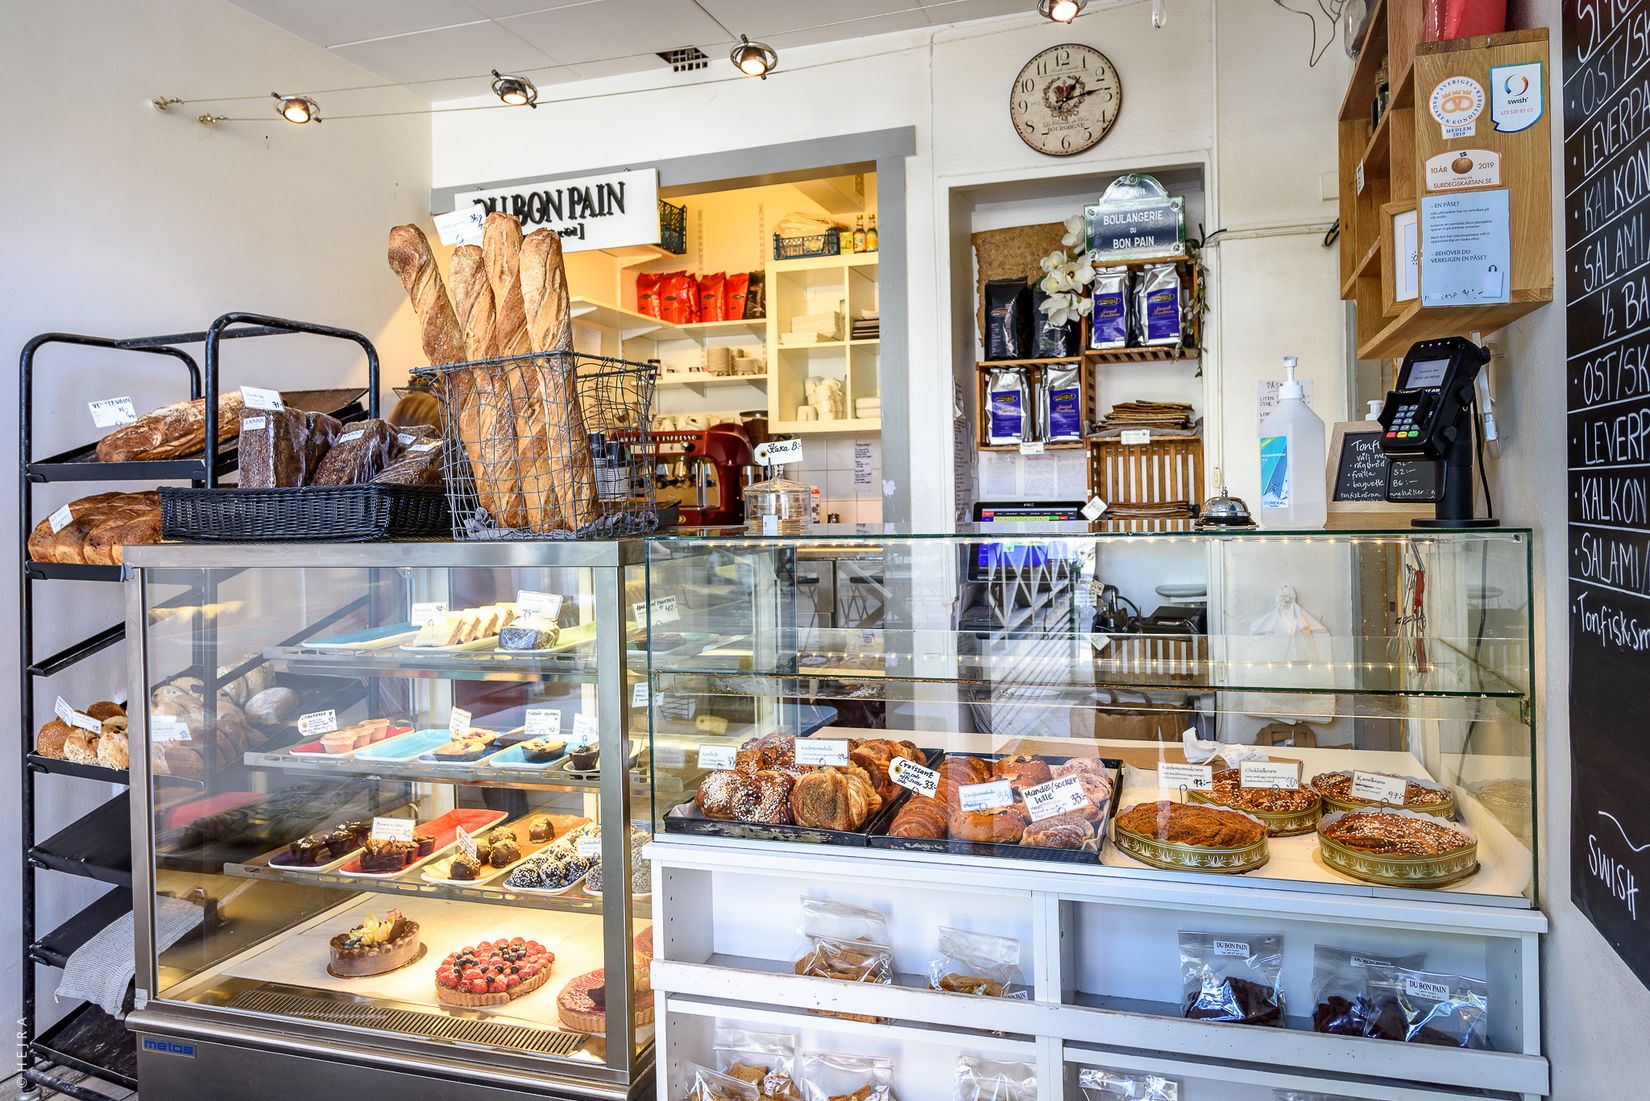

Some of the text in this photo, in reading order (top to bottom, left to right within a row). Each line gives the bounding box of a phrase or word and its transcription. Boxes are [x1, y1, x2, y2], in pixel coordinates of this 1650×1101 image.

[1478, 162, 1495, 170] 2019
[1584, 140, 1650, 231] KALKON
[510, 189, 563, 227] BON
[567, 181, 626, 220] PAIN
[1103, 210, 1164, 226] BOULANGERIE
[1112, 235, 1155, 250] BON PAIN
[1266, 380, 1284, 390] PÅS
[1581, 476, 1647, 524] KALKON
[1581, 532, 1650, 594] SALAMI/
[898, 760, 934, 778] Croissant
[1588, 834, 1640, 921] SWISH
[1410, 980, 1446, 994] DU BON PAIN
